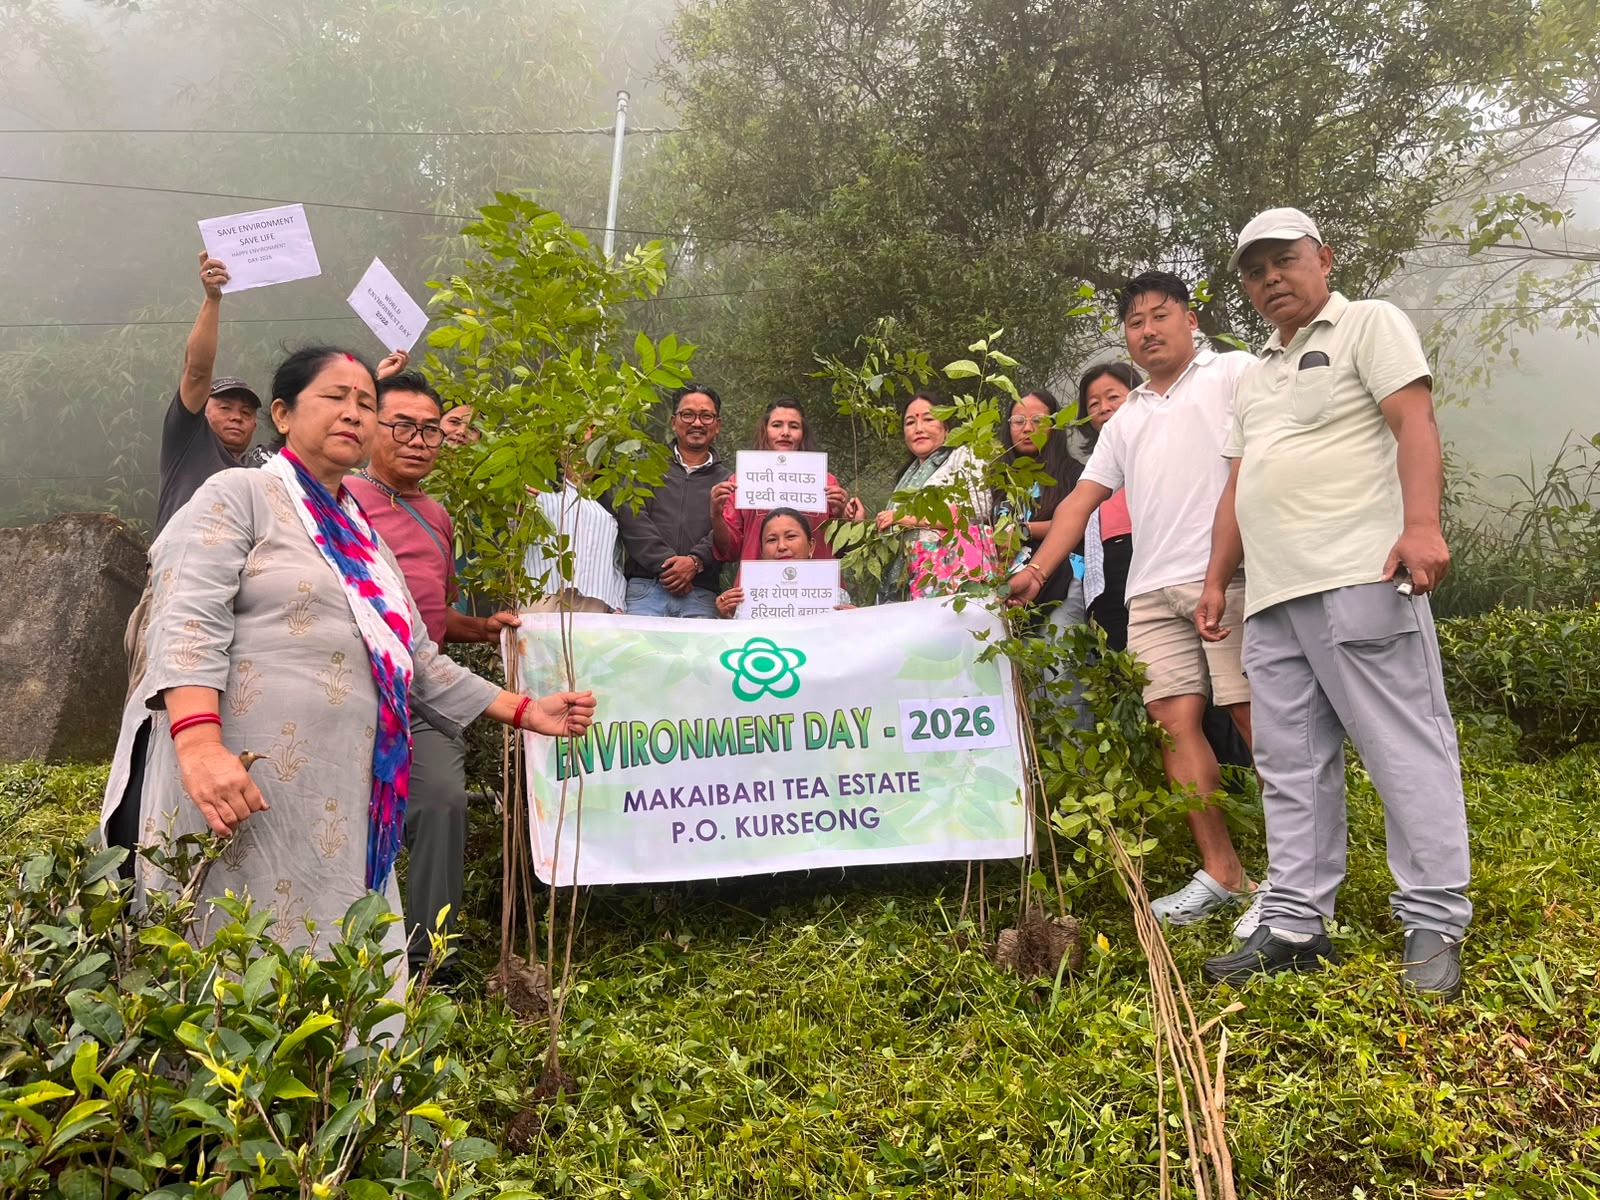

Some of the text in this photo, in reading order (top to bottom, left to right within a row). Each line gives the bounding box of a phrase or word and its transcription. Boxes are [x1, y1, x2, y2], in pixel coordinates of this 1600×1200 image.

[217, 216, 294, 237] SAVE ENVIRONMENT
[239, 232, 276, 246] SAVE LIFE
[249, 243, 286, 254] ENVIRONMENT
[367, 288, 412, 338] ENVIRONMENT DAY
[384, 294, 402, 315] WORLD
[746, 468, 816, 484] पानी बचाऊ
[745, 487, 817, 505] पृथ्वी बचाऊ
[750, 584, 832, 602] बृक्ष रोपण गराऊ
[751, 603, 795, 619] हरियाली
[556, 713, 794, 781] ENVIRONMENT
[803, 707, 872, 750] DAY
[908, 705, 996, 741] 2026
[623, 771, 921, 813] MAKAIBARI TEA ESTATE
[671, 806, 881, 844] P.O. KURSEONG
